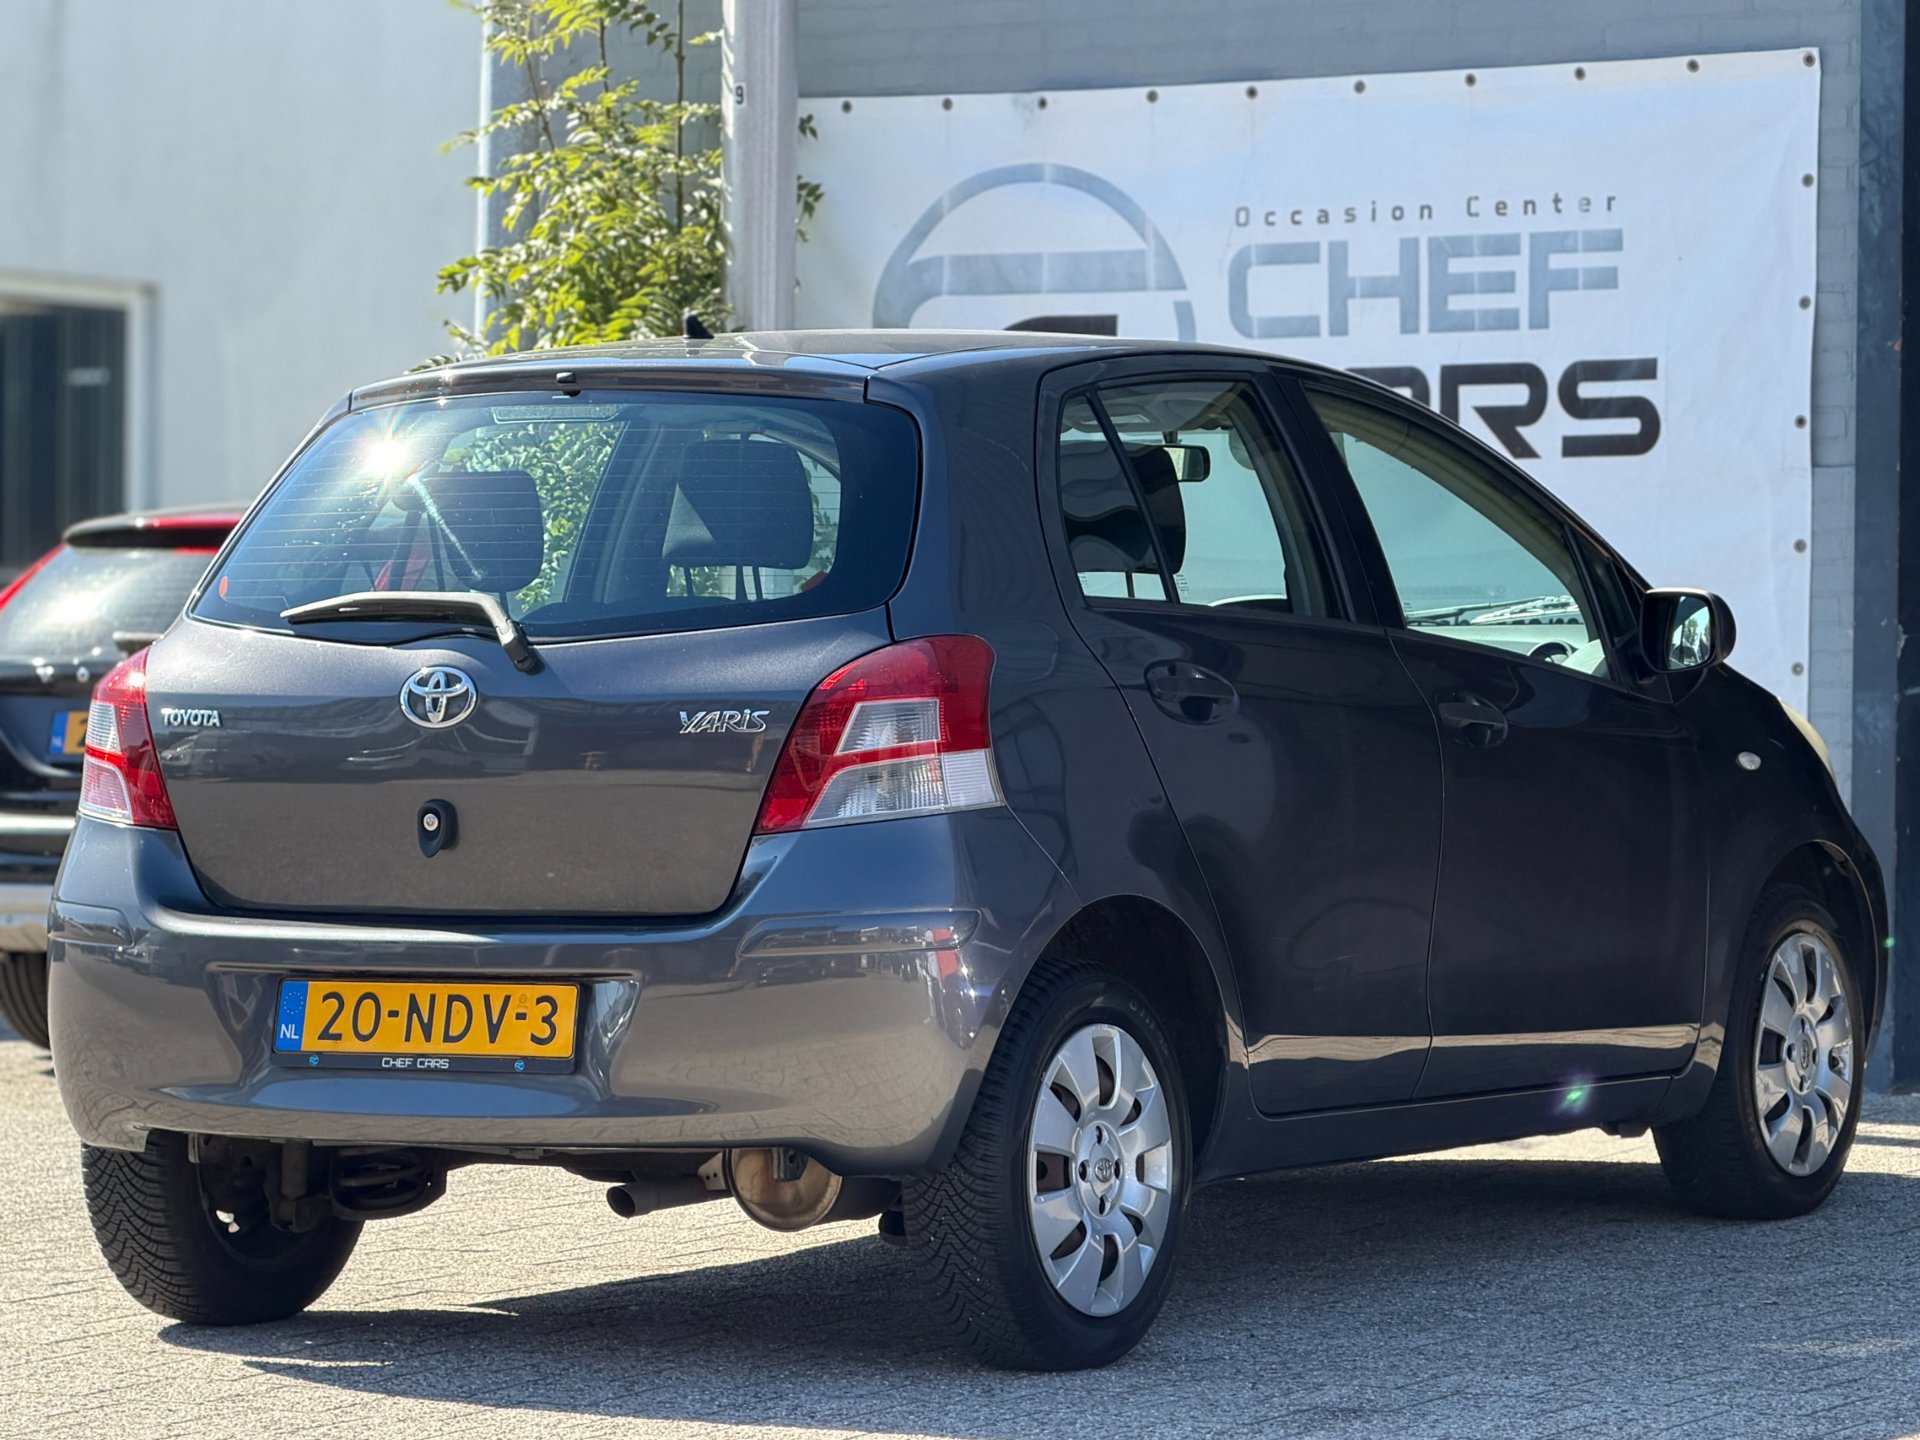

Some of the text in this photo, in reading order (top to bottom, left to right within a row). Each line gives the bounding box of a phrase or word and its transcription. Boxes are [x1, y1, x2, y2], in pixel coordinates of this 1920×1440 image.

[735, 85, 744, 105] 9
[1235, 192, 1616, 228] Occasion Center
[1228, 228, 1624, 339] CHEF
[161, 708, 220, 727] TOYOTA
[280, 991, 559, 1046] NL 20-NDV-3
[381, 1057, 450, 1069] CHEF CARS
